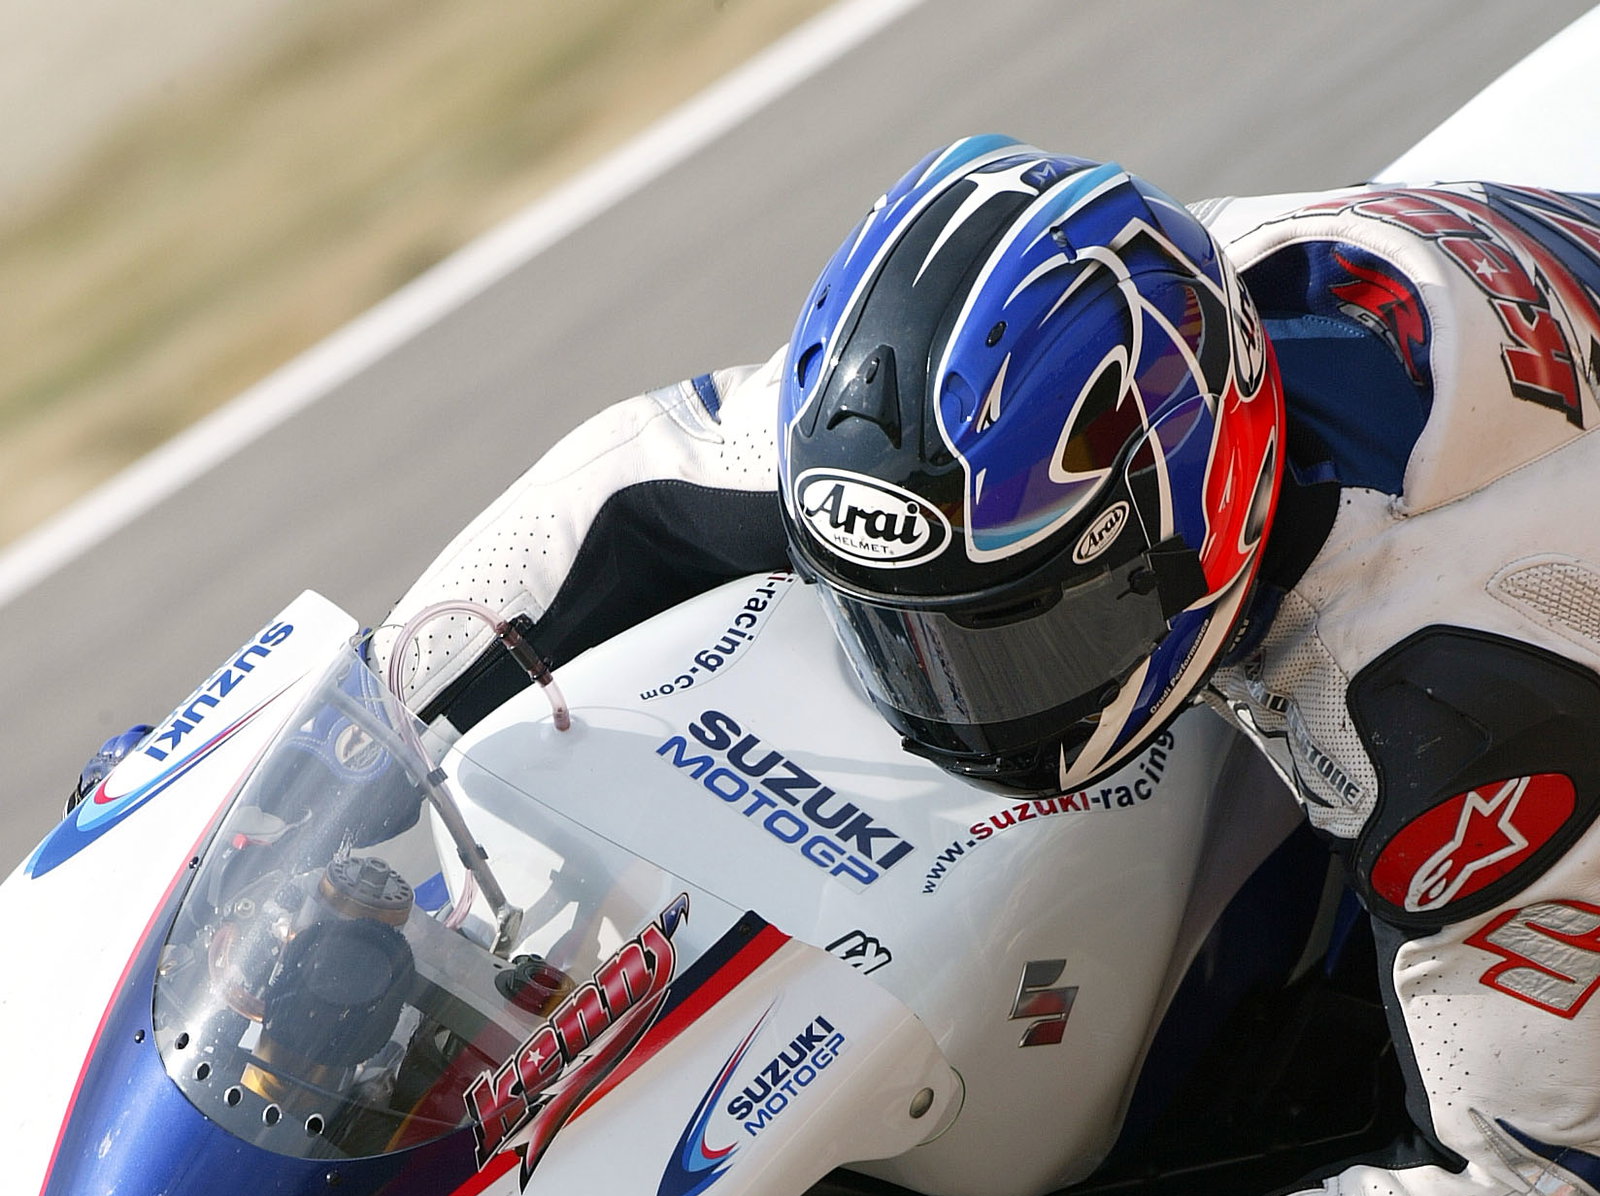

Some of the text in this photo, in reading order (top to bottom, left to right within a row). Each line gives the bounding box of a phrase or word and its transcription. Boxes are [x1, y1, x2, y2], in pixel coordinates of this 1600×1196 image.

[805, 483, 923, 545] Arai
[834, 534, 889, 555] HELMET
[1082, 508, 1121, 558] Arai
[640, 571, 794, 700] i-racing.com
[144, 621, 294, 762] SUZUKI
[656, 735, 880, 885] MOTOGP
[688, 710, 915, 871] SUZUKI
[727, 1015, 835, 1121] SUZUKI
[743, 1032, 846, 1137] MOTOGP
